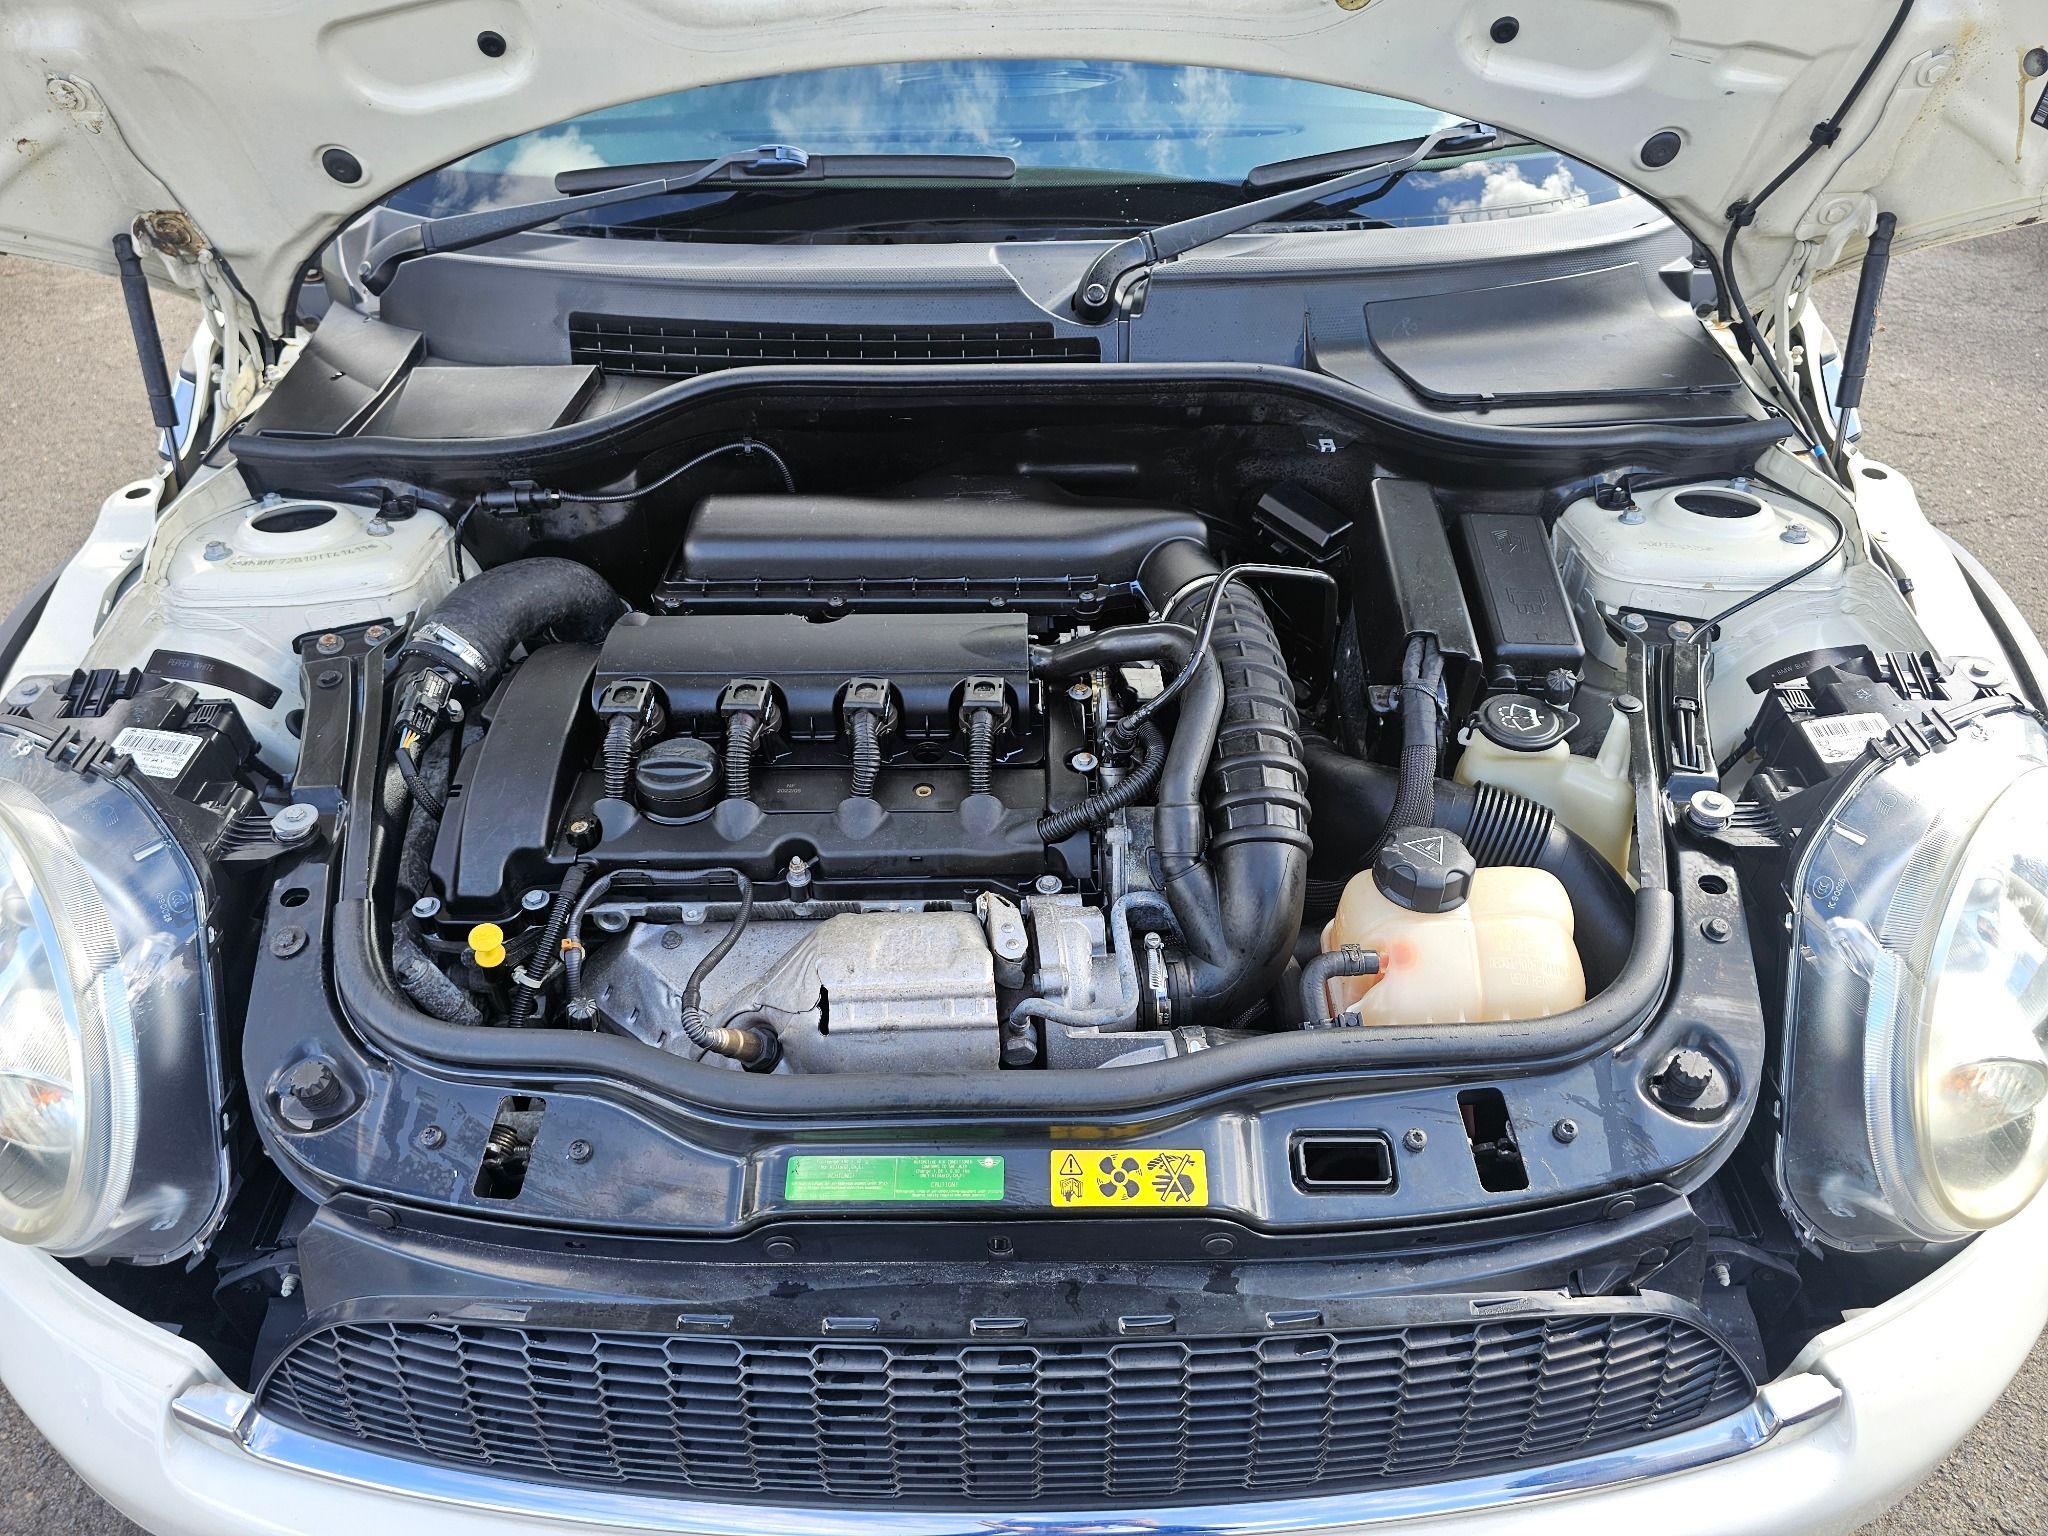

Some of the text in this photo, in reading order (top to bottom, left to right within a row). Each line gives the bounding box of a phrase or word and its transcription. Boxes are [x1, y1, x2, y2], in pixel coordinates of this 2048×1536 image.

[168, 659, 215, 672] PEPPER WHITE
[1776, 665, 1793, 676] BMW
